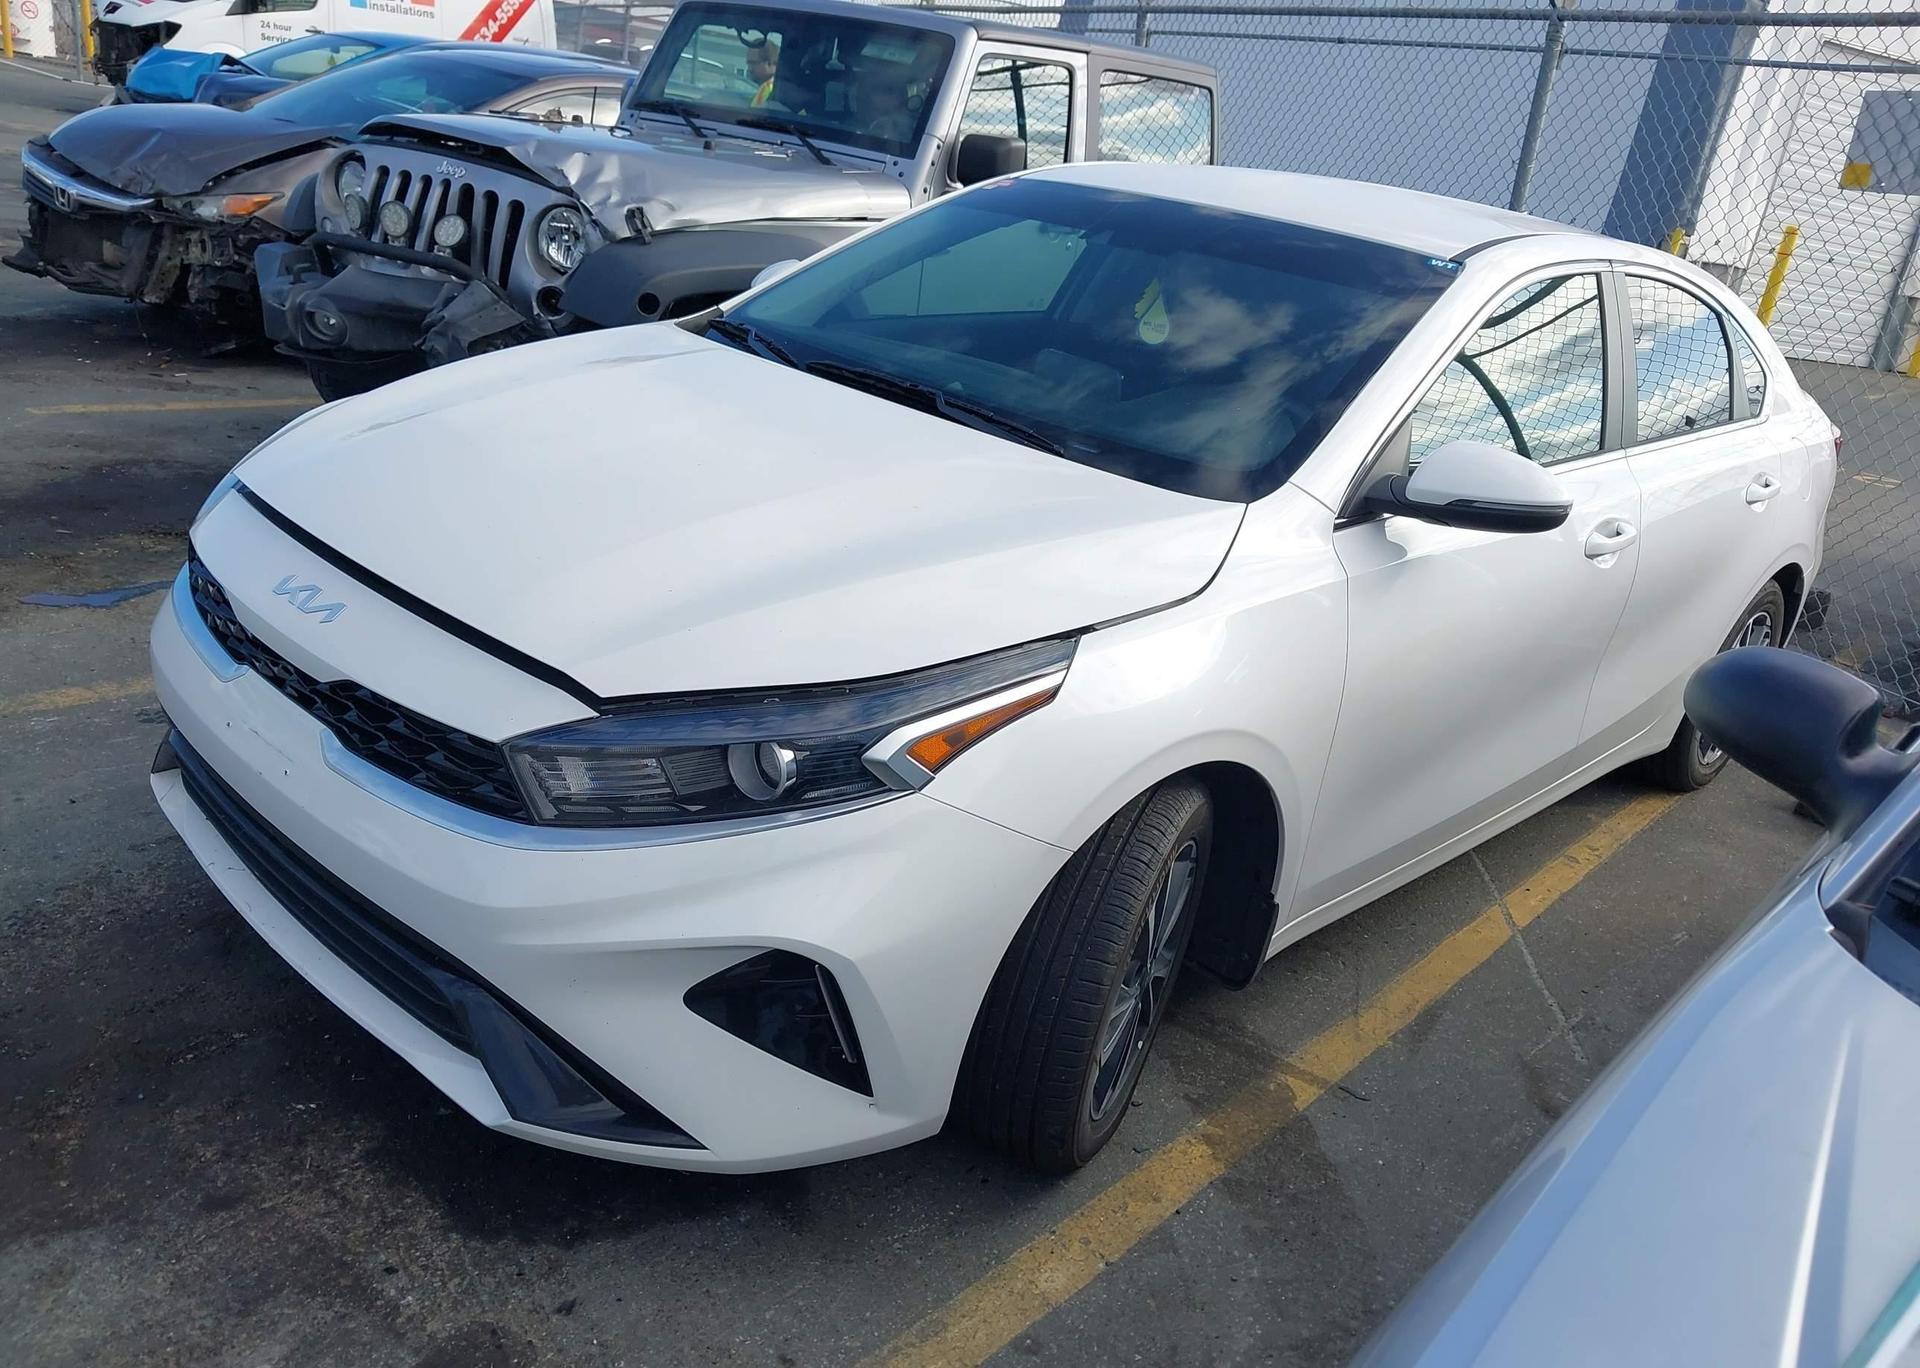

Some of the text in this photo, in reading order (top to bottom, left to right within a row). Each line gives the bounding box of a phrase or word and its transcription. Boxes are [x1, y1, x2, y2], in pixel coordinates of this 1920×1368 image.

[368, 2, 435, 19] installations
[260, 20, 292, 32] 24 hour
[436, 160, 466, 178] Jeep
[272, 574, 348, 624] KIA
